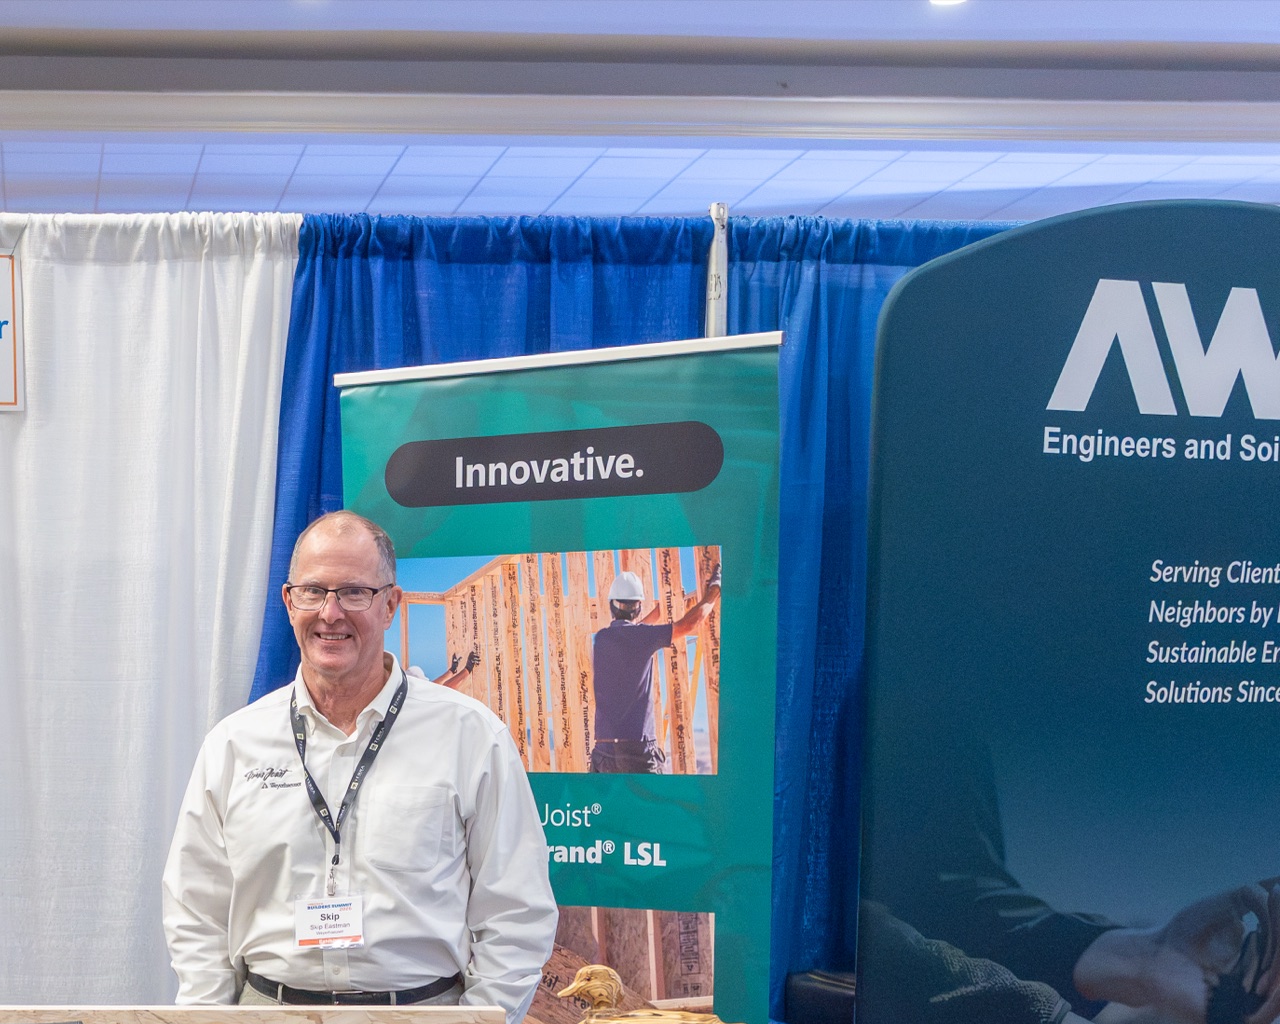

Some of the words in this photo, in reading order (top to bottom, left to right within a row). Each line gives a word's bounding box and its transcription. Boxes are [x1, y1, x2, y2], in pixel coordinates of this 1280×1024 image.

[1043, 426, 1176, 463] Engineers
[1184, 434, 1231, 460] and
[454, 449, 645, 489] Innovative.
[1150, 559, 1222, 588] Serving
[1149, 600, 1245, 628] Neighbors
[1250, 600, 1274, 628] by
[1146, 640, 1257, 663] Sustainable
[1144, 680, 1232, 704] Solutions
[624, 842, 667, 867] LSL
[320, 913, 340, 921] Skip
